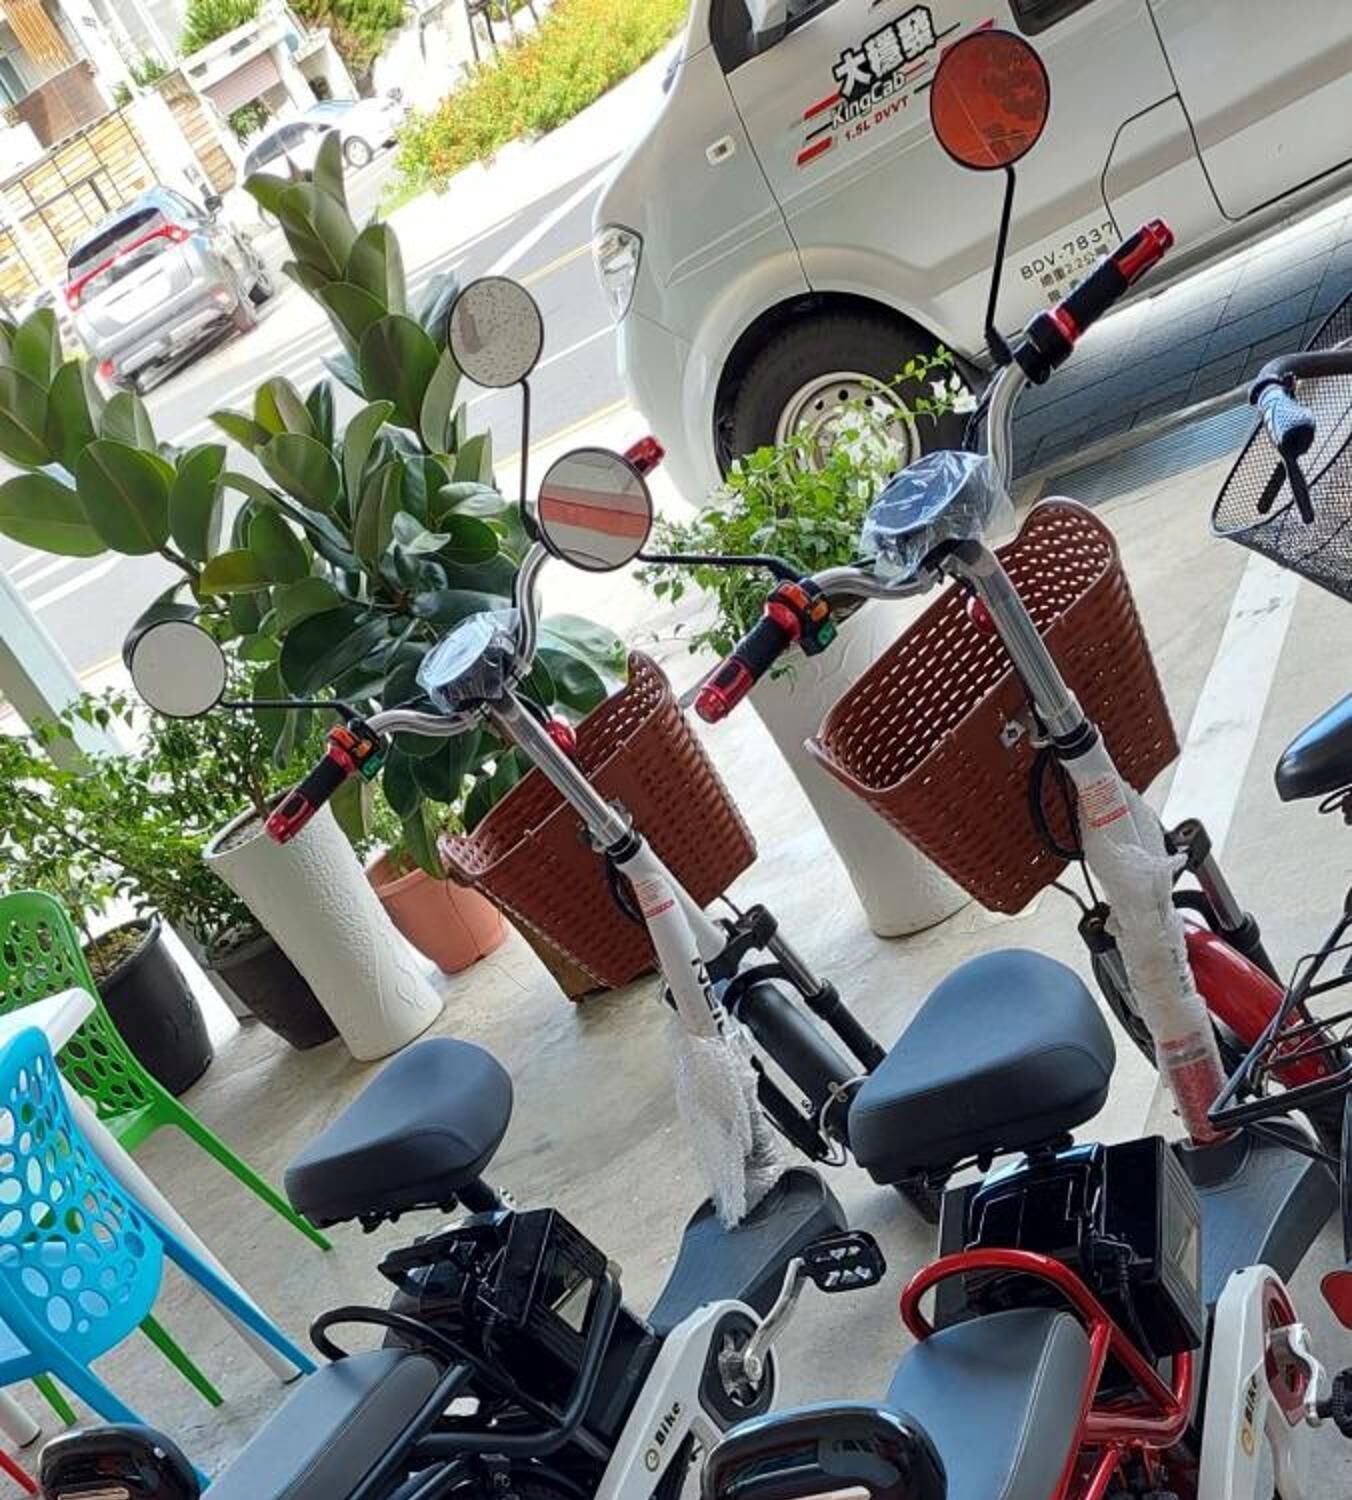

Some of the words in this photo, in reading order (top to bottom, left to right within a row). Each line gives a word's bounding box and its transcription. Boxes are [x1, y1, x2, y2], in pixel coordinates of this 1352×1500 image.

[831, 71, 906, 130] KingCab
[845, 120, 871, 141] 1.5L
[874, 95, 910, 123] DVVT
[1020, 221, 1113, 280] BDV-7837
[655, 1401, 680, 1446] Bike
